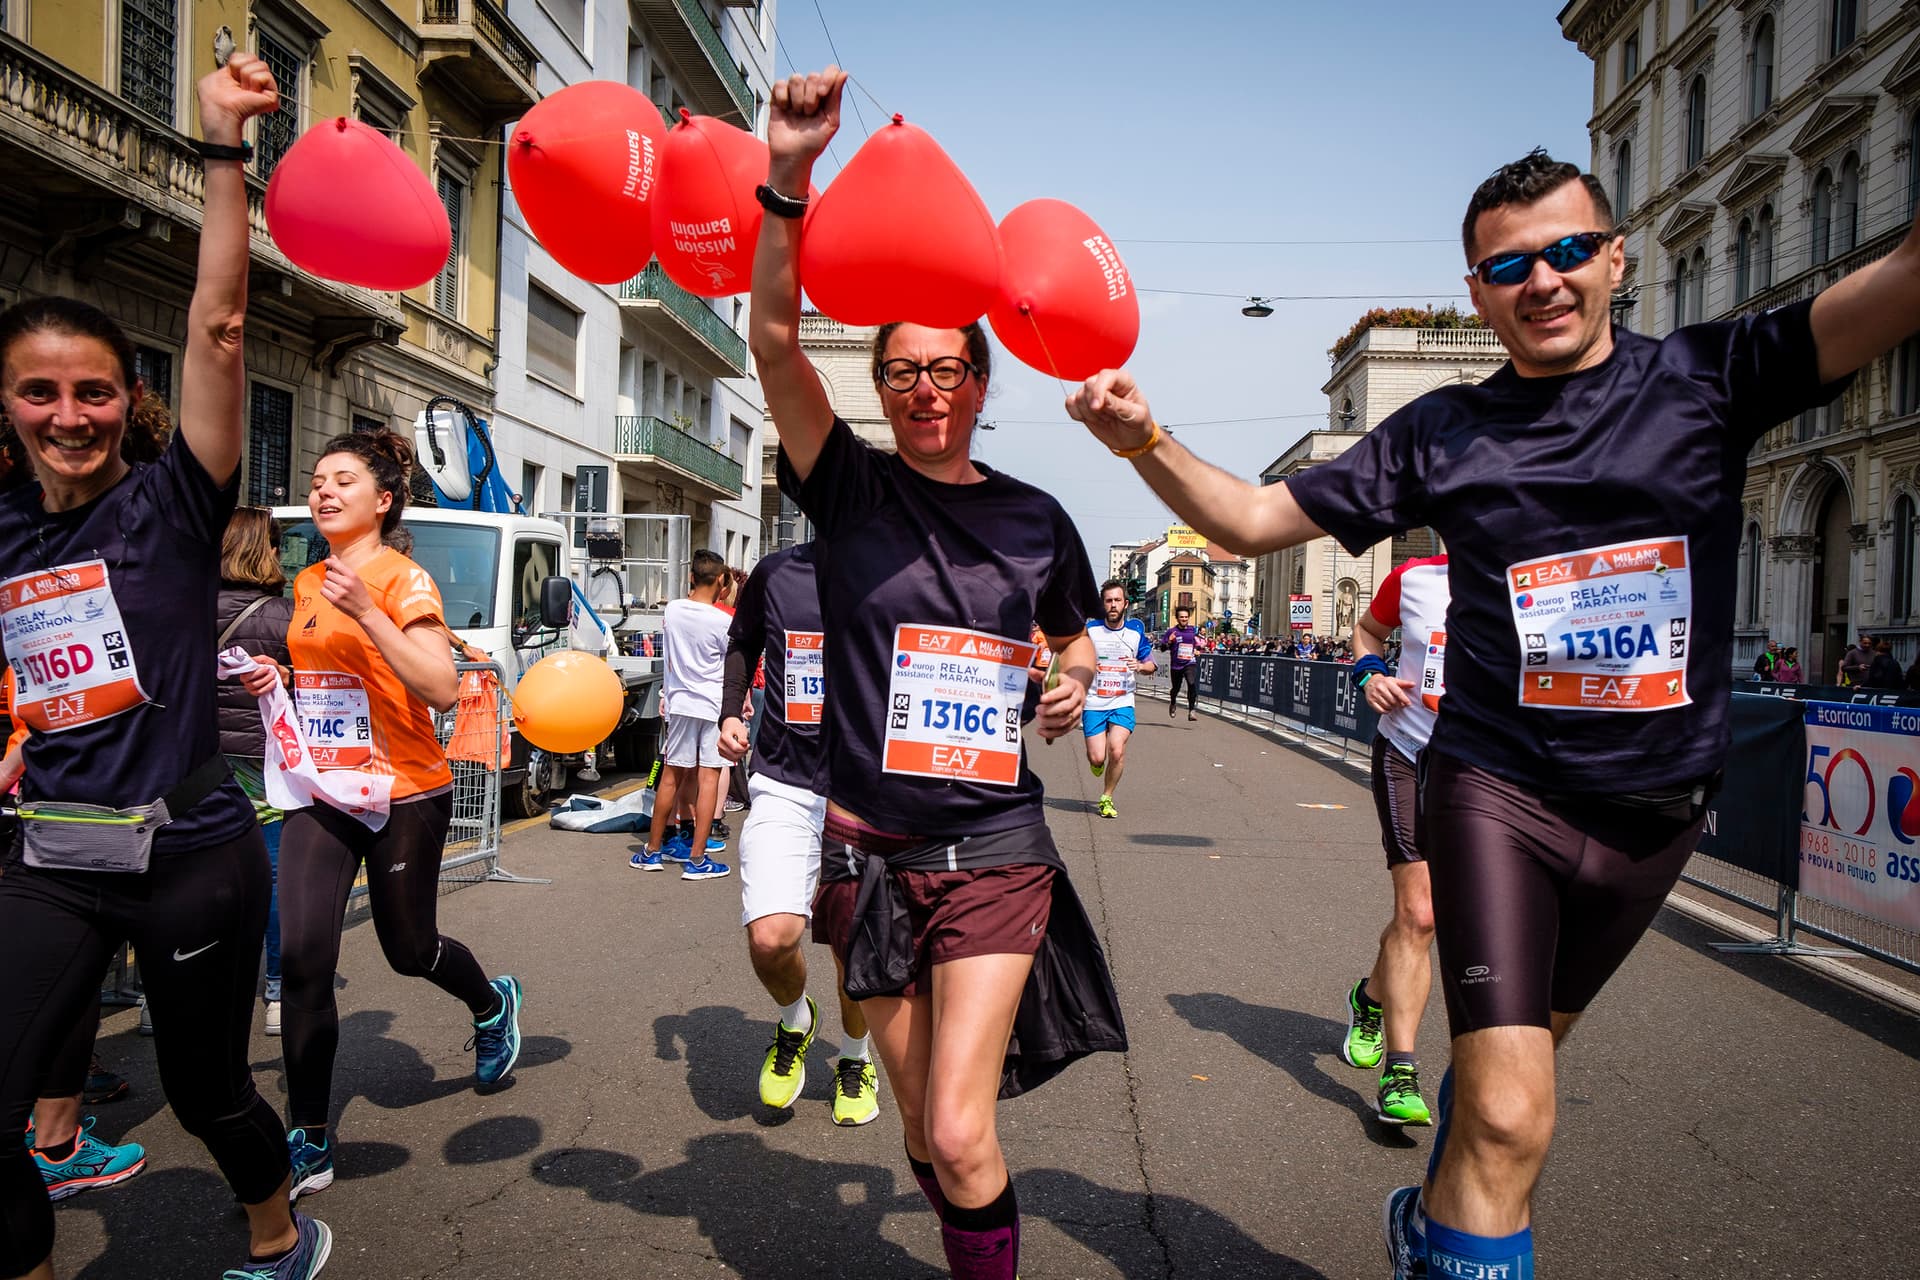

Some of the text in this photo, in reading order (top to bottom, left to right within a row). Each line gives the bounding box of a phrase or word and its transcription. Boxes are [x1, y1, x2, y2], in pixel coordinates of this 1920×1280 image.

[623, 129, 642, 198] Bambini
[637, 135, 656, 202] Mission
[671, 218, 731, 240] Bambini
[675, 236, 736, 256] Mission
[1082, 238, 1120, 301] Bambini
[1093, 235, 1127, 296] Mission
[1612, 549, 1660, 563] MILANO
[1535, 562, 1574, 582] EA7
[1536, 596, 1565, 607] europ
[1570, 584, 1620, 601] RELAY
[1573, 592, 1647, 611] MARATHON
[15, 609, 46, 626] RELAY
[1292, 605, 1311, 613] 200
[1519, 606, 1566, 619] assistance
[1626, 610, 1646, 618] TEAM
[18, 615, 73, 634] MARATHON
[54, 632, 74, 642] TEAM
[795, 637, 812, 646] EA7
[919, 633, 952, 649] EA7
[1559, 623, 1659, 661] 1316A
[980, 641, 1014, 656] MILANO
[23, 643, 95, 687] 1316D
[895, 669, 934, 680] assistance
[912, 661, 935, 672] europ
[940, 662, 979, 675] RELAY
[939, 673, 996, 688] MARATHON
[1581, 676, 1642, 700] EA7
[977, 692, 992, 700] TEAM
[43, 693, 86, 721] EA7
[1817, 706, 1872, 727] #corricon
[922, 699, 999, 736] 1316C
[308, 719, 345, 738] 714C
[312, 748, 339, 762] EA7
[932, 746, 981, 770] EA7
[1843, 842, 1877, 868] 2018
[1808, 854, 1834, 870] PROVA
[1837, 863, 1846, 875] DI
[1848, 865, 1877, 884] FUTURO
[1432, 1253, 1510, 1280] OXI-JET
